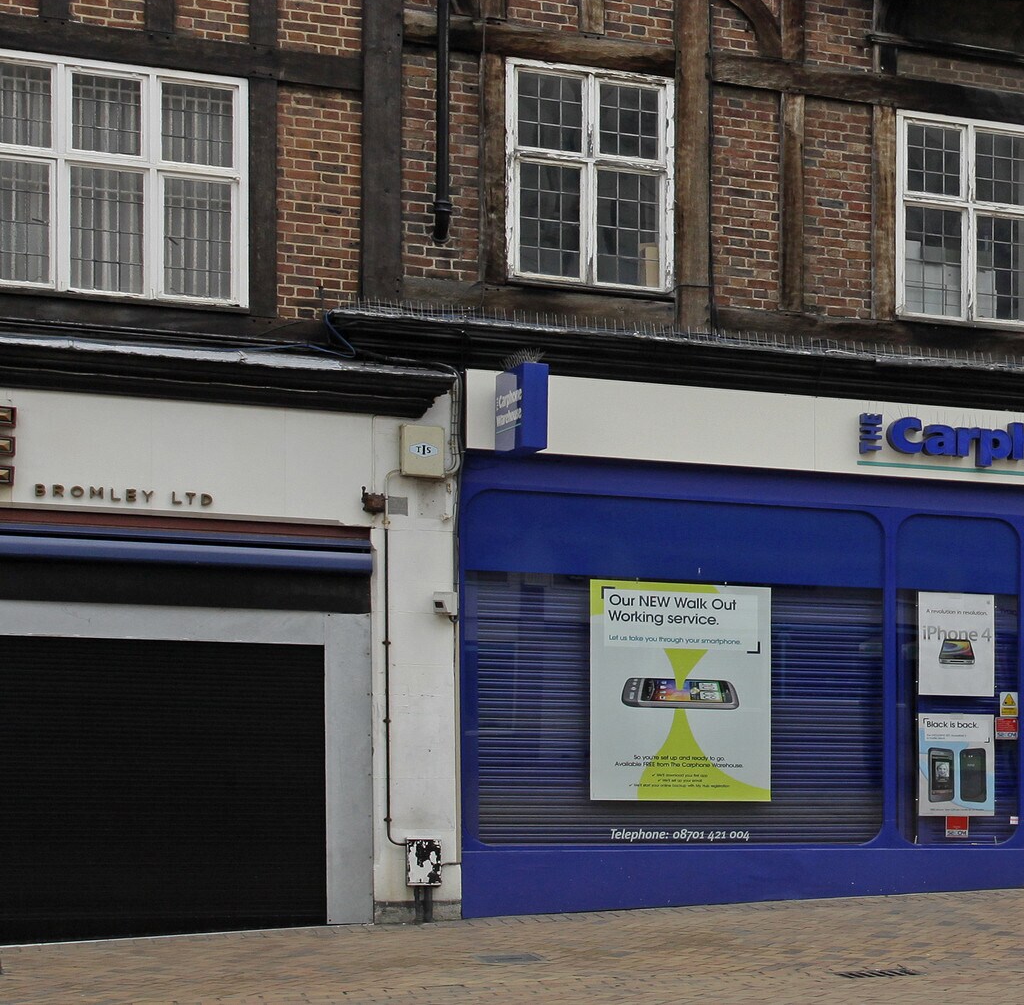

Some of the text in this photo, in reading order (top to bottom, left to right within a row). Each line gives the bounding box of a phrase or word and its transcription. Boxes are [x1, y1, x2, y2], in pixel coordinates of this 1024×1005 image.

[859, 412, 883, 455] THE
[415, 444, 432, 455] TIS
[34, 483, 213, 506] BROMLEY LTD
[609, 594, 737, 611] Our NEW Walk Out
[608, 610, 720, 626] Working service.
[645, 636, 657, 644] you
[659, 635, 685, 645] through
[685, 637, 700, 645] your
[701, 637, 742, 646] smartphone.
[922, 625, 992, 642] iPhone 4
[926, 720, 948, 728] Black
[957, 721, 979, 729] back.
[681, 761, 711, 769] Carphone
[610, 828, 750, 842] Telephone: 08701 421 004
